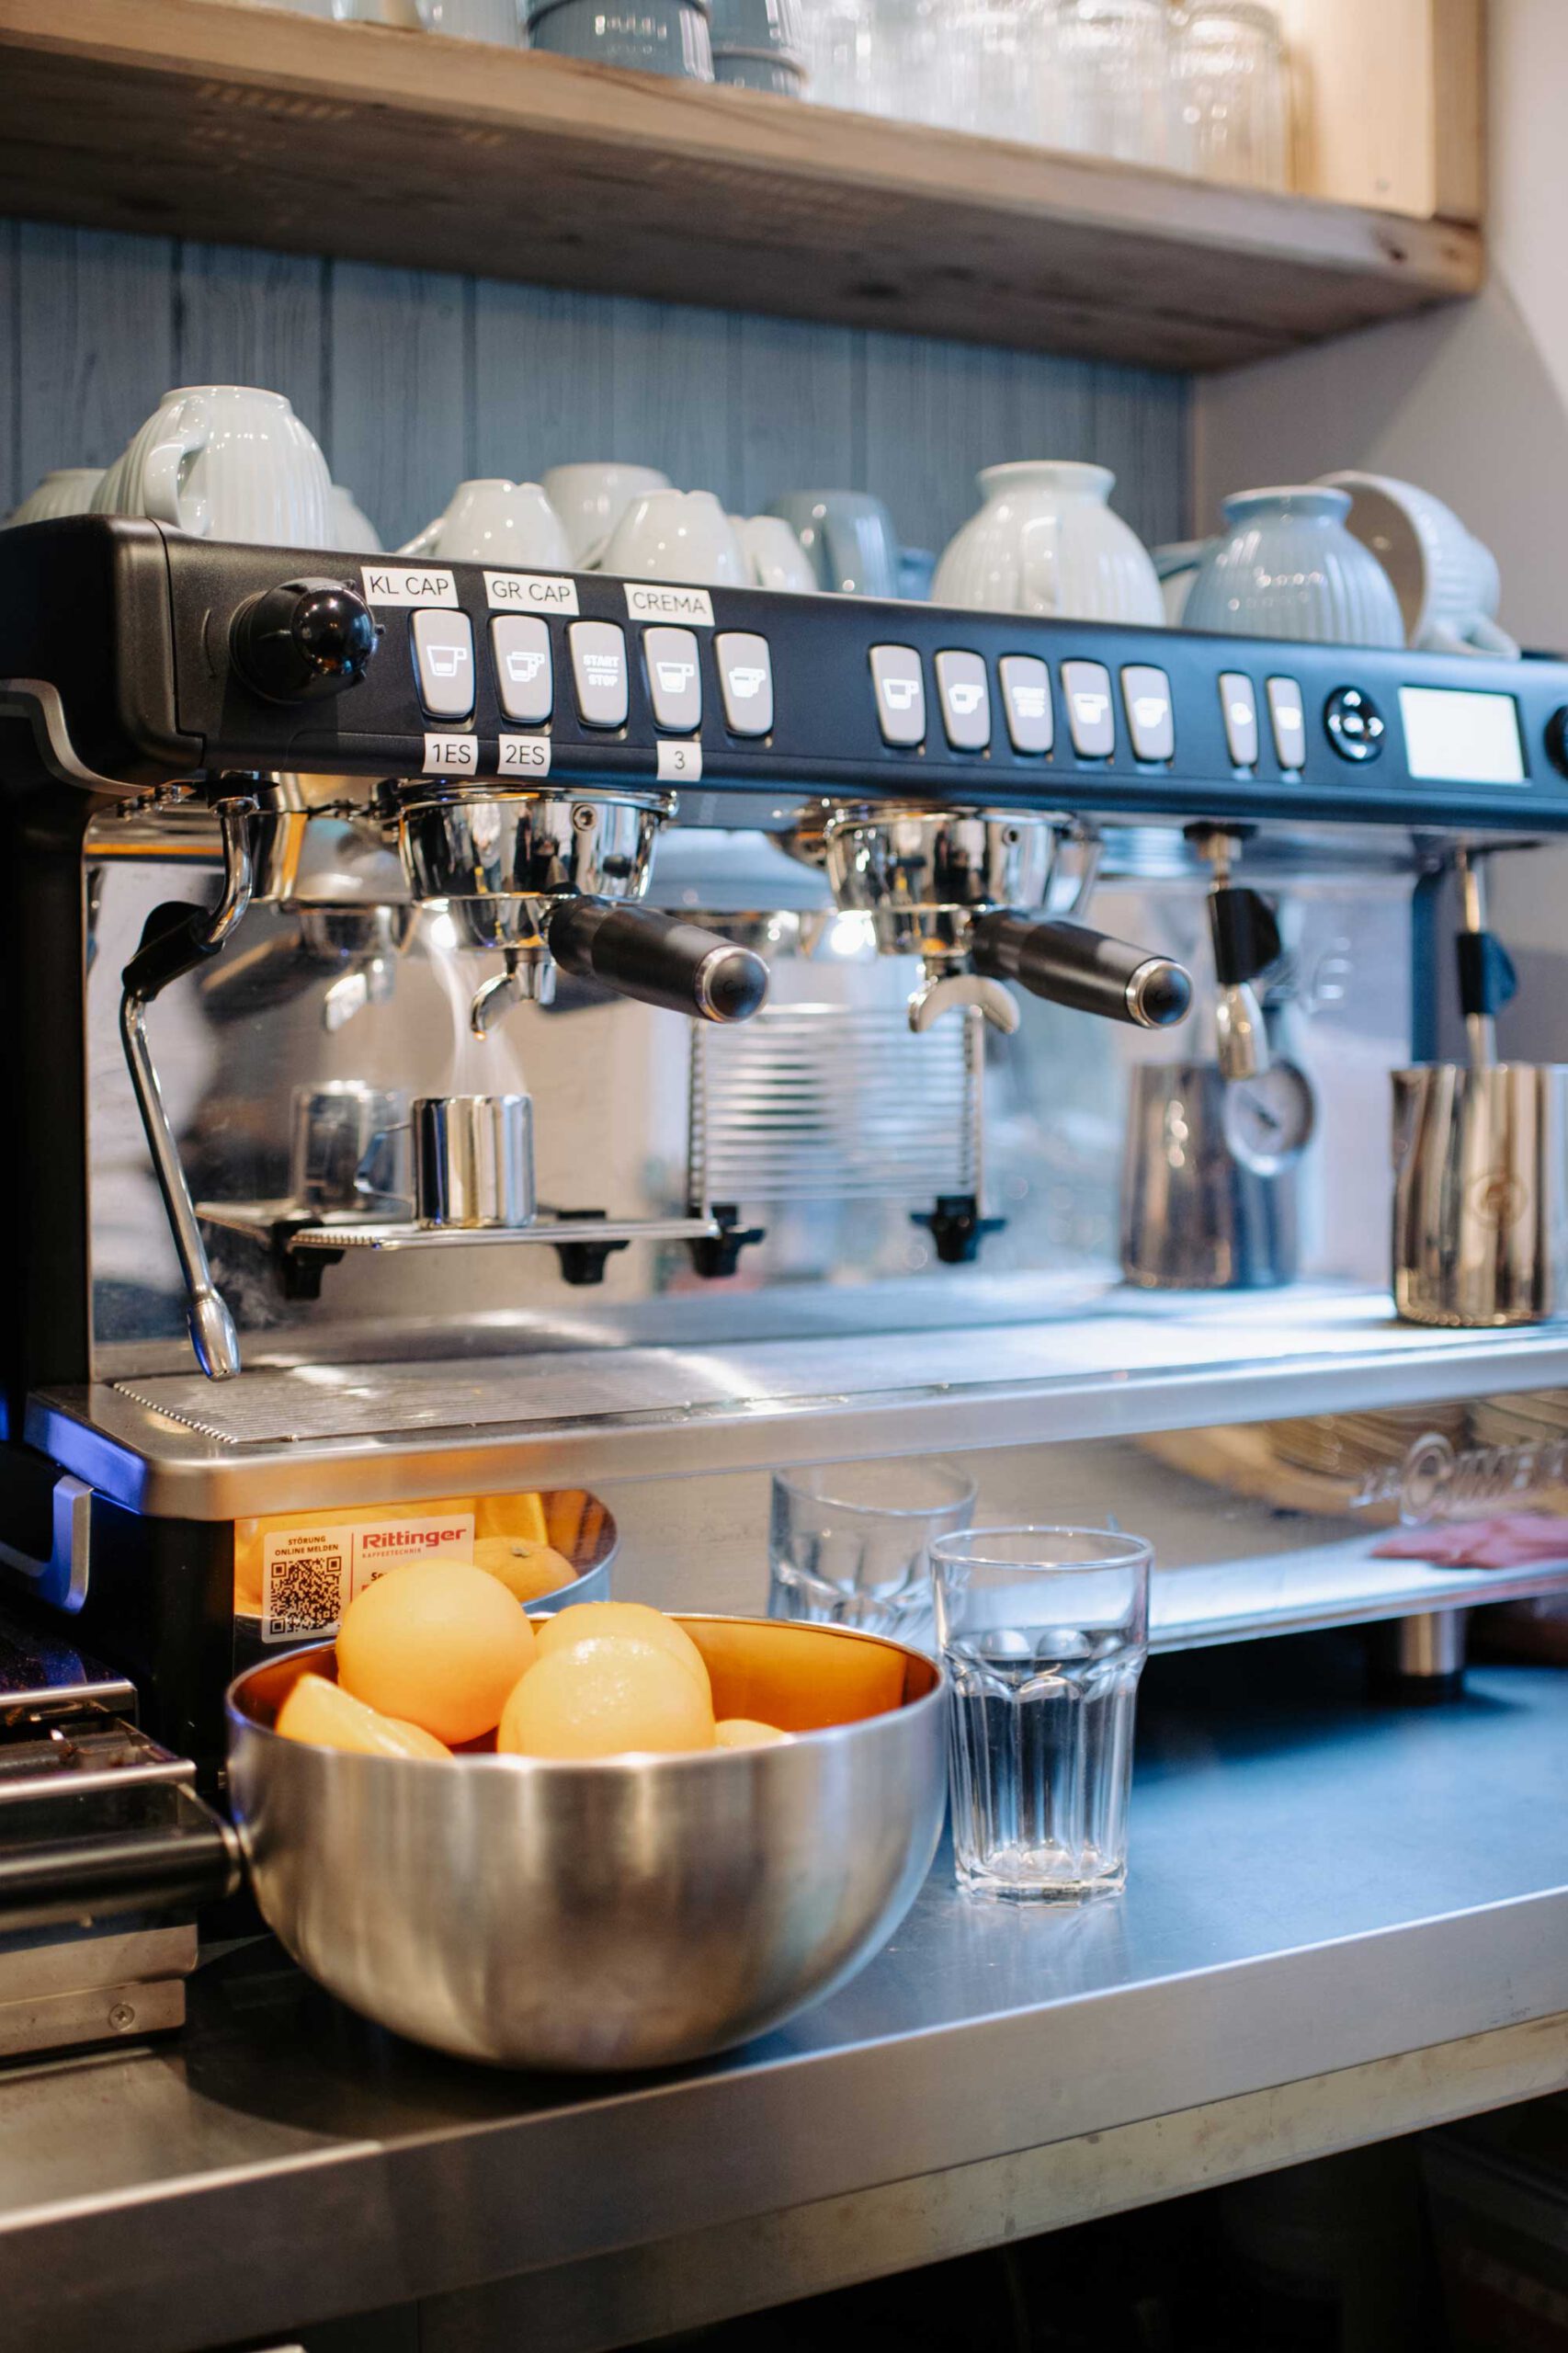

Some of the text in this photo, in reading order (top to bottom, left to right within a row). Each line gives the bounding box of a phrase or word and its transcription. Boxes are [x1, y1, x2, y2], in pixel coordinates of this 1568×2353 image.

[369, 575, 449, 596] KL CAP
[492, 580, 571, 602] GR CAP
[633, 591, 707, 615] CREMA
[583, 654, 619, 667] START
[588, 675, 619, 687] STOP
[432, 744, 472, 764] 1ES
[506, 744, 545, 766] 2ES
[675, 750, 686, 770] 3
[275, 1544, 339, 1556] ONLINE MELDEN
[288, 1535, 326, 1546] STÖRUNG
[362, 1529, 467, 1551] Rittinger
